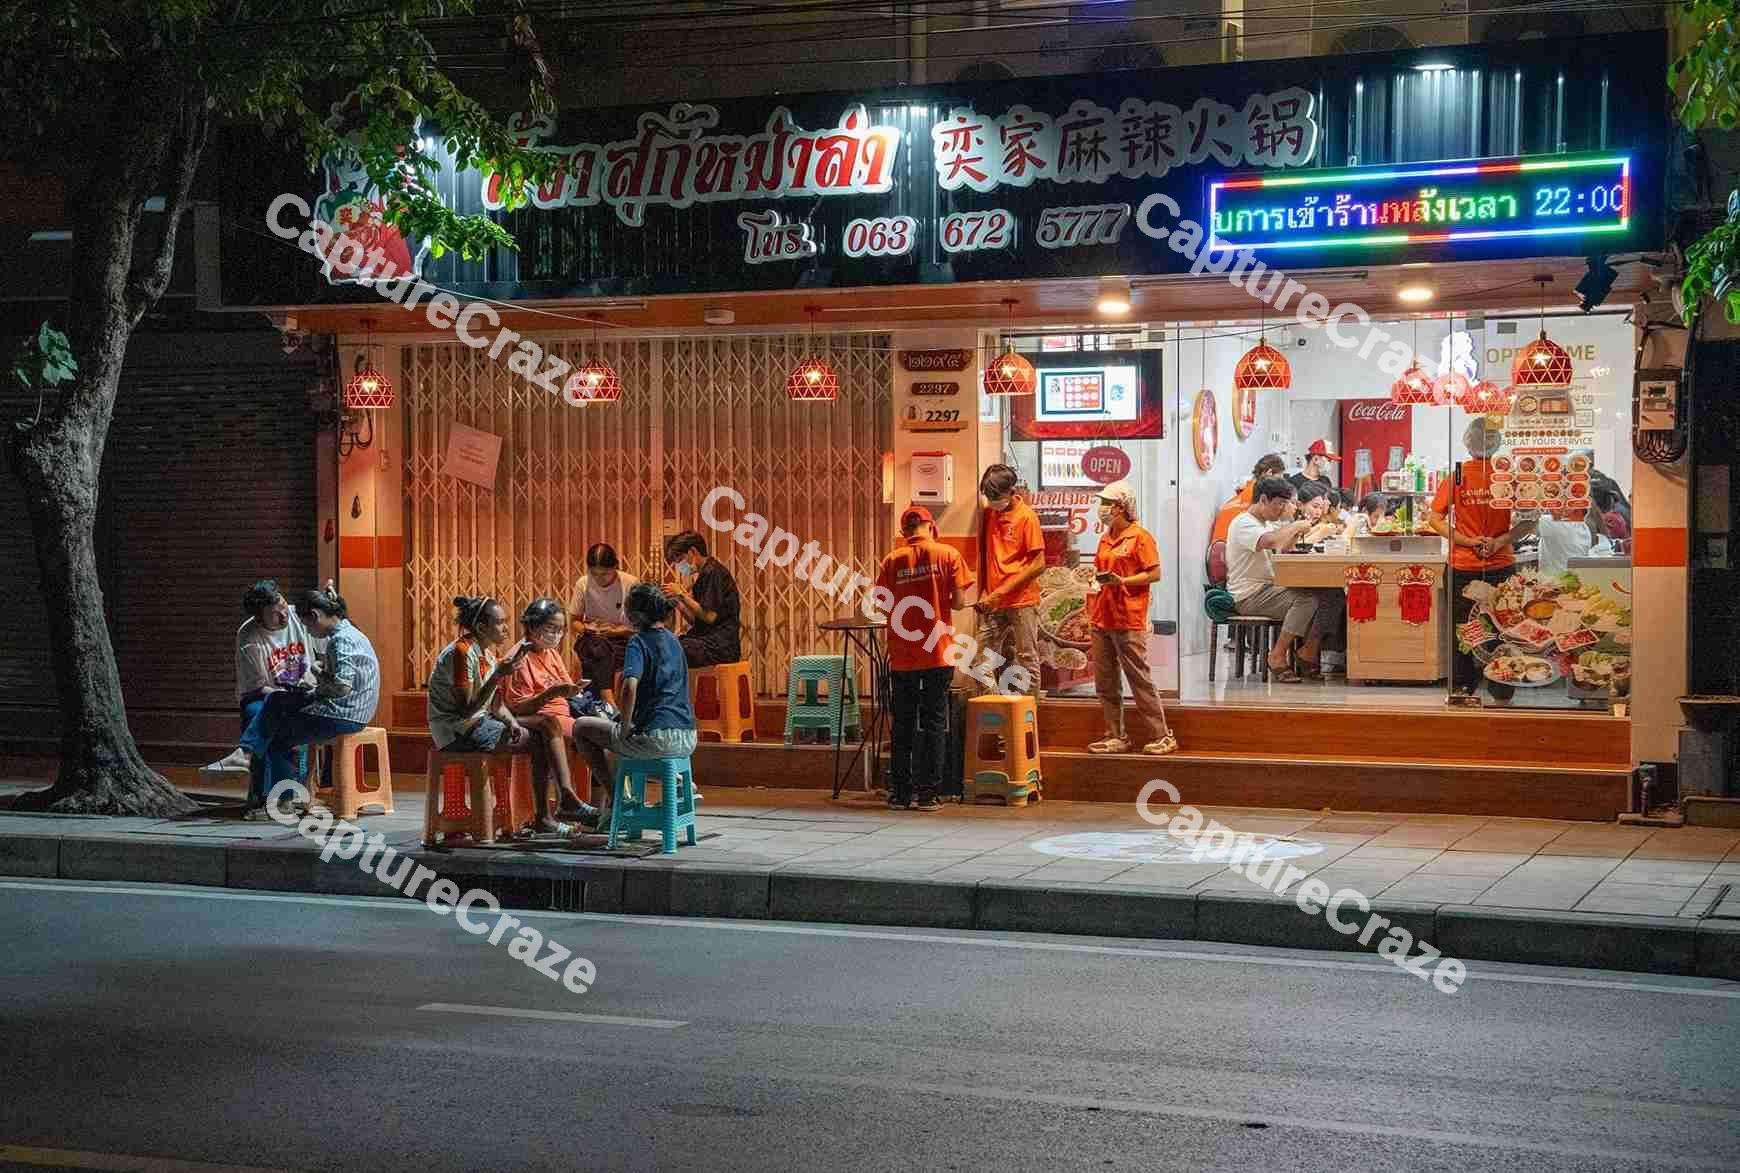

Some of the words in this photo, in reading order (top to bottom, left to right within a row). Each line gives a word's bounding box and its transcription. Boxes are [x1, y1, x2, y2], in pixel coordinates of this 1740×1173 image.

[939, 98, 1305, 184] 奕家麻辣火锅
[1535, 184, 1626, 216] 22:00
[846, 219, 908, 252] 063
[944, 213, 1007, 247] 672
[1039, 207, 1126, 244] 5777
[926, 410, 960, 422] 2297
[1520, 438, 1530, 446] AT
[1532, 437, 1557, 446] YOUR
[1559, 437, 1593, 446] SERVICE
[1090, 456, 1121, 474] OPEN
